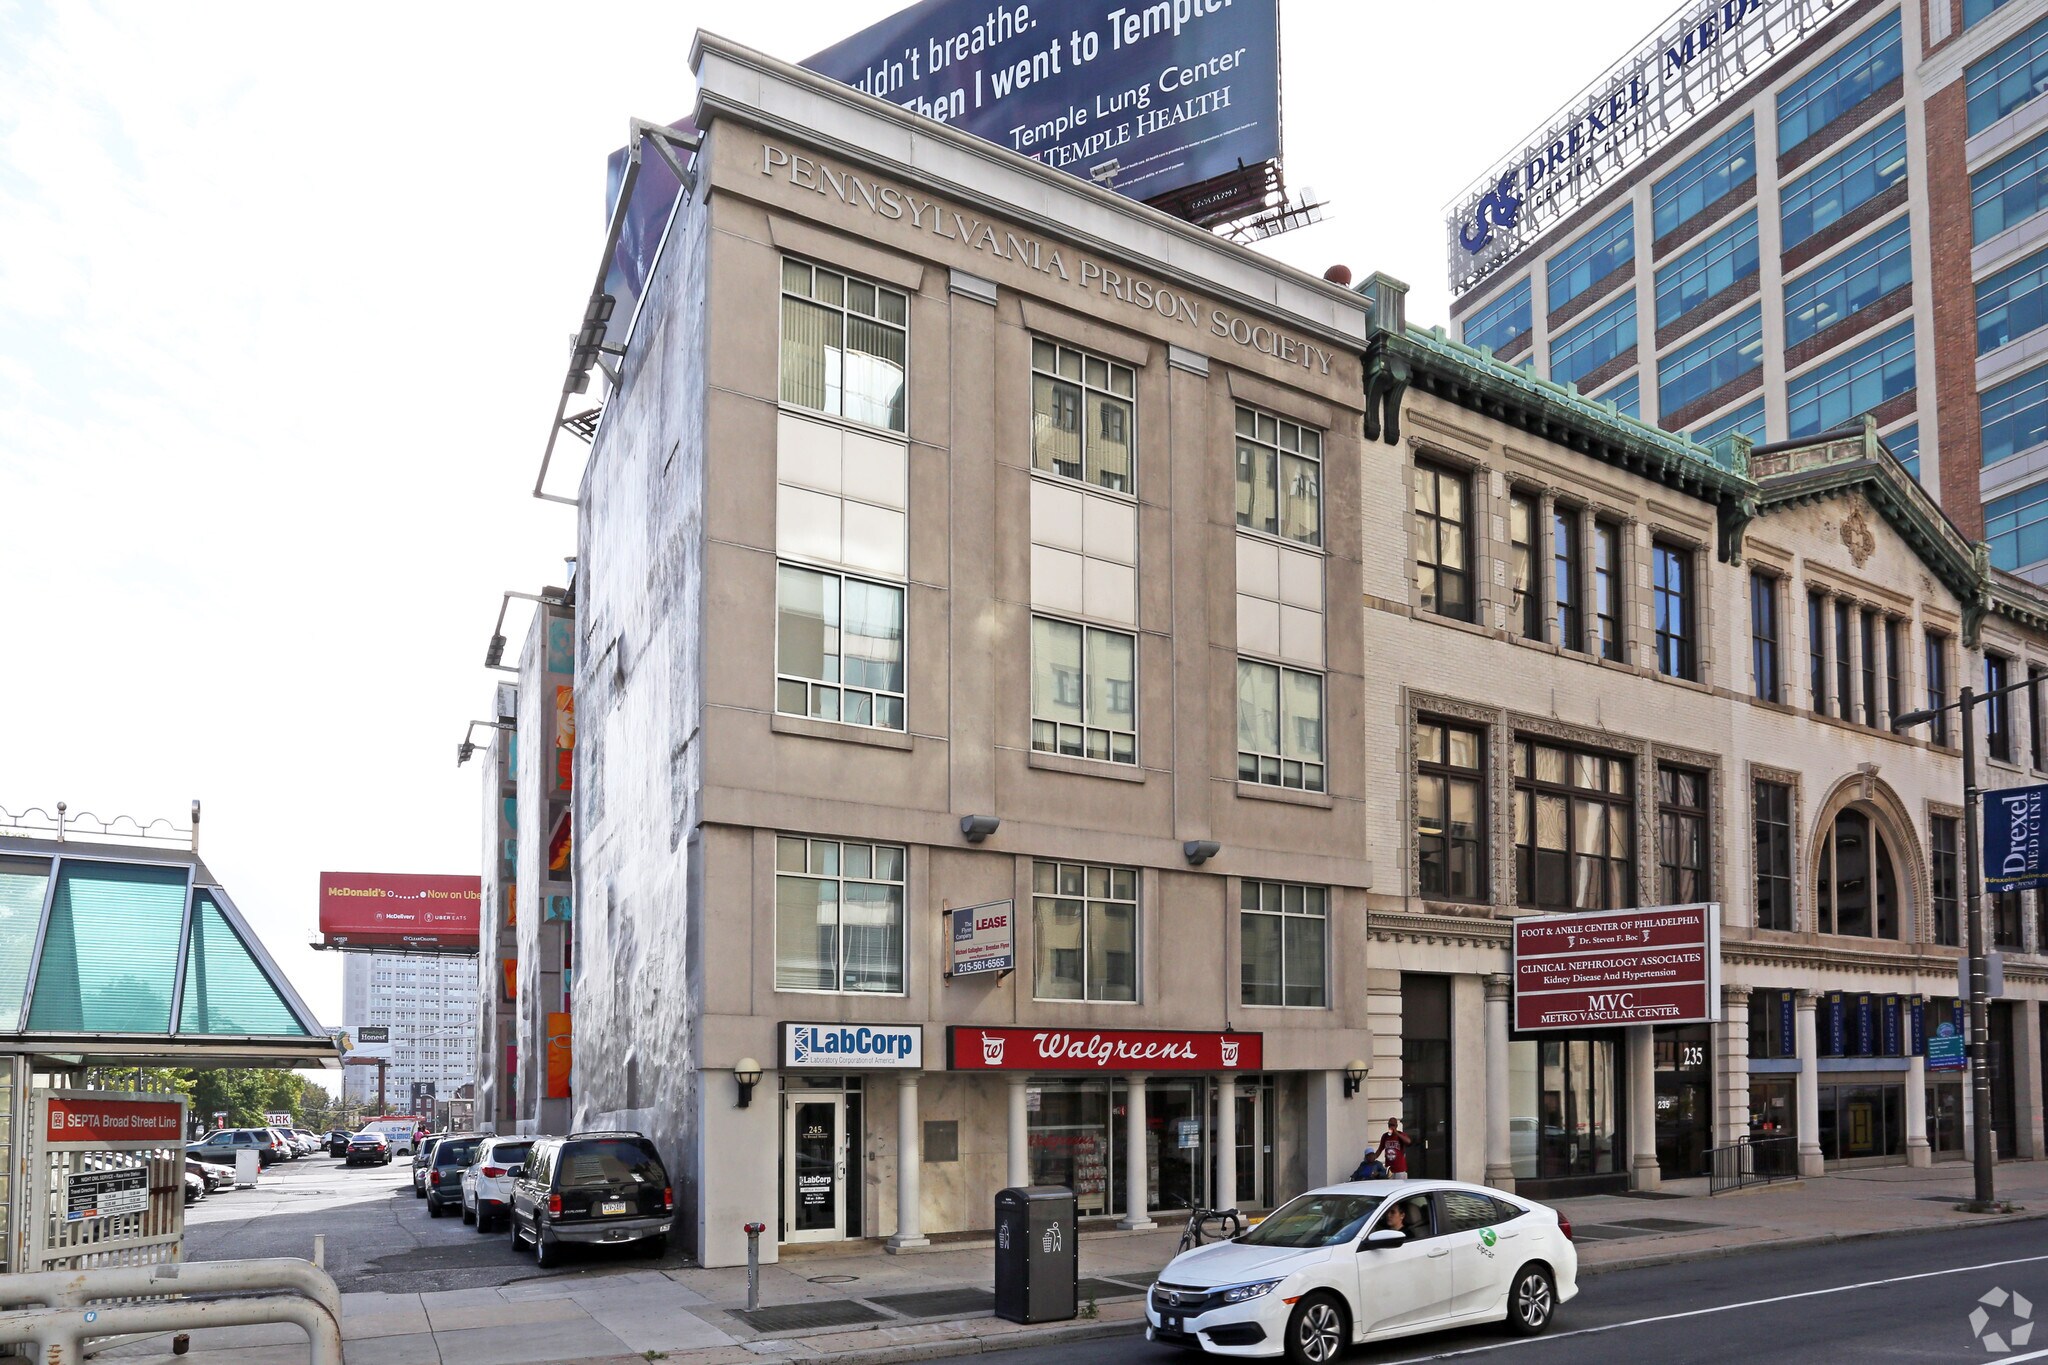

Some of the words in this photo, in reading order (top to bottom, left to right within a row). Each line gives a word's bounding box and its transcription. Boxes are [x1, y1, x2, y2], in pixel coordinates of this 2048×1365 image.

[929, 4, 1037, 73] breathe.
[975, 70, 982, 109] I
[991, 42, 1061, 99] went
[1071, 31, 1098, 66] to
[1009, 105, 1088, 149] Temple
[1096, 82, 1151, 118] Lung
[1158, 48, 1246, 92] Center
[1044, 123, 1131, 168] TEMPLE
[1136, 86, 1231, 139] HEALTH
[1525, 75, 1649, 190] DREXEL
[1536, 156, 1592, 207] CENTER
[1604, 118, 1639, 153] CITY
[761, 143, 1069, 281] PENNSYLVANIA
[1079, 259, 1199, 328] PRISON
[1210, 310, 1334, 375] SOCIETY
[2002, 793, 2028, 876] Drexel
[2027, 792, 2042, 870] MEDICINE
[328, 887, 386, 898] McDonald's
[427, 890, 448, 899] Now
[386, 913, 415, 921] McDelivery
[975, 915, 1007, 931] LEASE
[1521, 927, 1545, 938] FOOT
[1546, 926, 1554, 935] &
[1555, 925, 1584, 935] ANKLE
[1585, 923, 1619, 933] CENTER
[1620, 921, 1633, 930] OF
[1634, 916, 1700, 929] PHILADELPHIA
[1579, 937, 1591, 945] Dr.
[1592, 935, 1615, 944] Steven
[1625, 934, 1638, 942] Boc
[1521, 961, 1566, 974] CLINICAL
[1568, 957, 1638, 971] NEPHROLOGY
[1640, 953, 1701, 966] ASSOCIATES
[1543, 975, 1571, 985] Kidney
[1573, 972, 1601, 983] Disease
[1603, 971, 1620, 980] And
[1622, 968, 1677, 980] Hypertension
[1587, 992, 1634, 1012] MVC
[1541, 1012, 1578, 1024] METRO
[1580, 1009, 1635, 1020] VASCULAR
[1637, 1006, 1680, 1018] CENTER
[811, 1027, 913, 1059] LabCorp
[1033, 1033, 1198, 1066] Walgreens
[810, 1056, 838, 1065] Laboratory
[838, 1056, 868, 1064] Corporation
[1683, 1047, 1703, 1065] 235
[1657, 1101, 1670, 1109] 235
[67, 1113, 100, 1127] SEPTA
[102, 1115, 129, 1127] Broad
[131, 1115, 157, 1128] Street
[158, 1115, 176, 1128] Line
[266, 1115, 289, 1124] ARK
[808, 1125, 823, 1134] 245
[803, 1175, 832, 1184] LabCorp
[1476, 1242, 1495, 1259] zipcar
